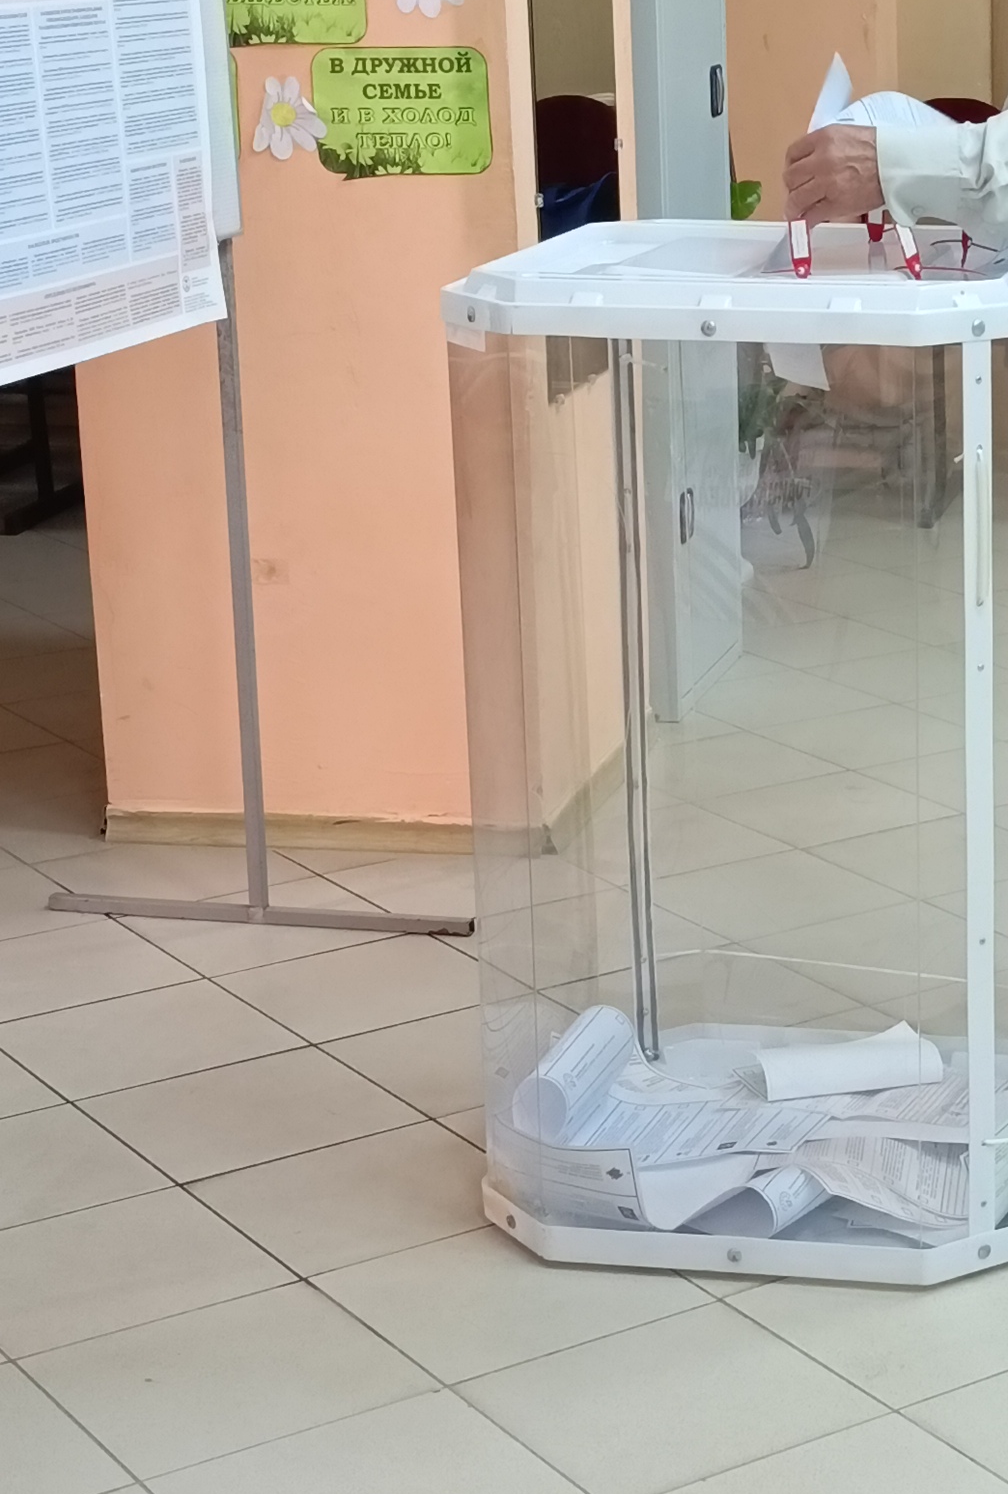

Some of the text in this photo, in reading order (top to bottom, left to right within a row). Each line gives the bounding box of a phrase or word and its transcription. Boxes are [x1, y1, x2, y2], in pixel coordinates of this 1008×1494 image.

[329, 51, 473, 76] В ДРУЖНОЙ
[362, 83, 443, 100] СЕМЬЕ
[330, 107, 477, 126] И В ХОЛОД
[355, 132, 452, 149] ТЕПЛО!
